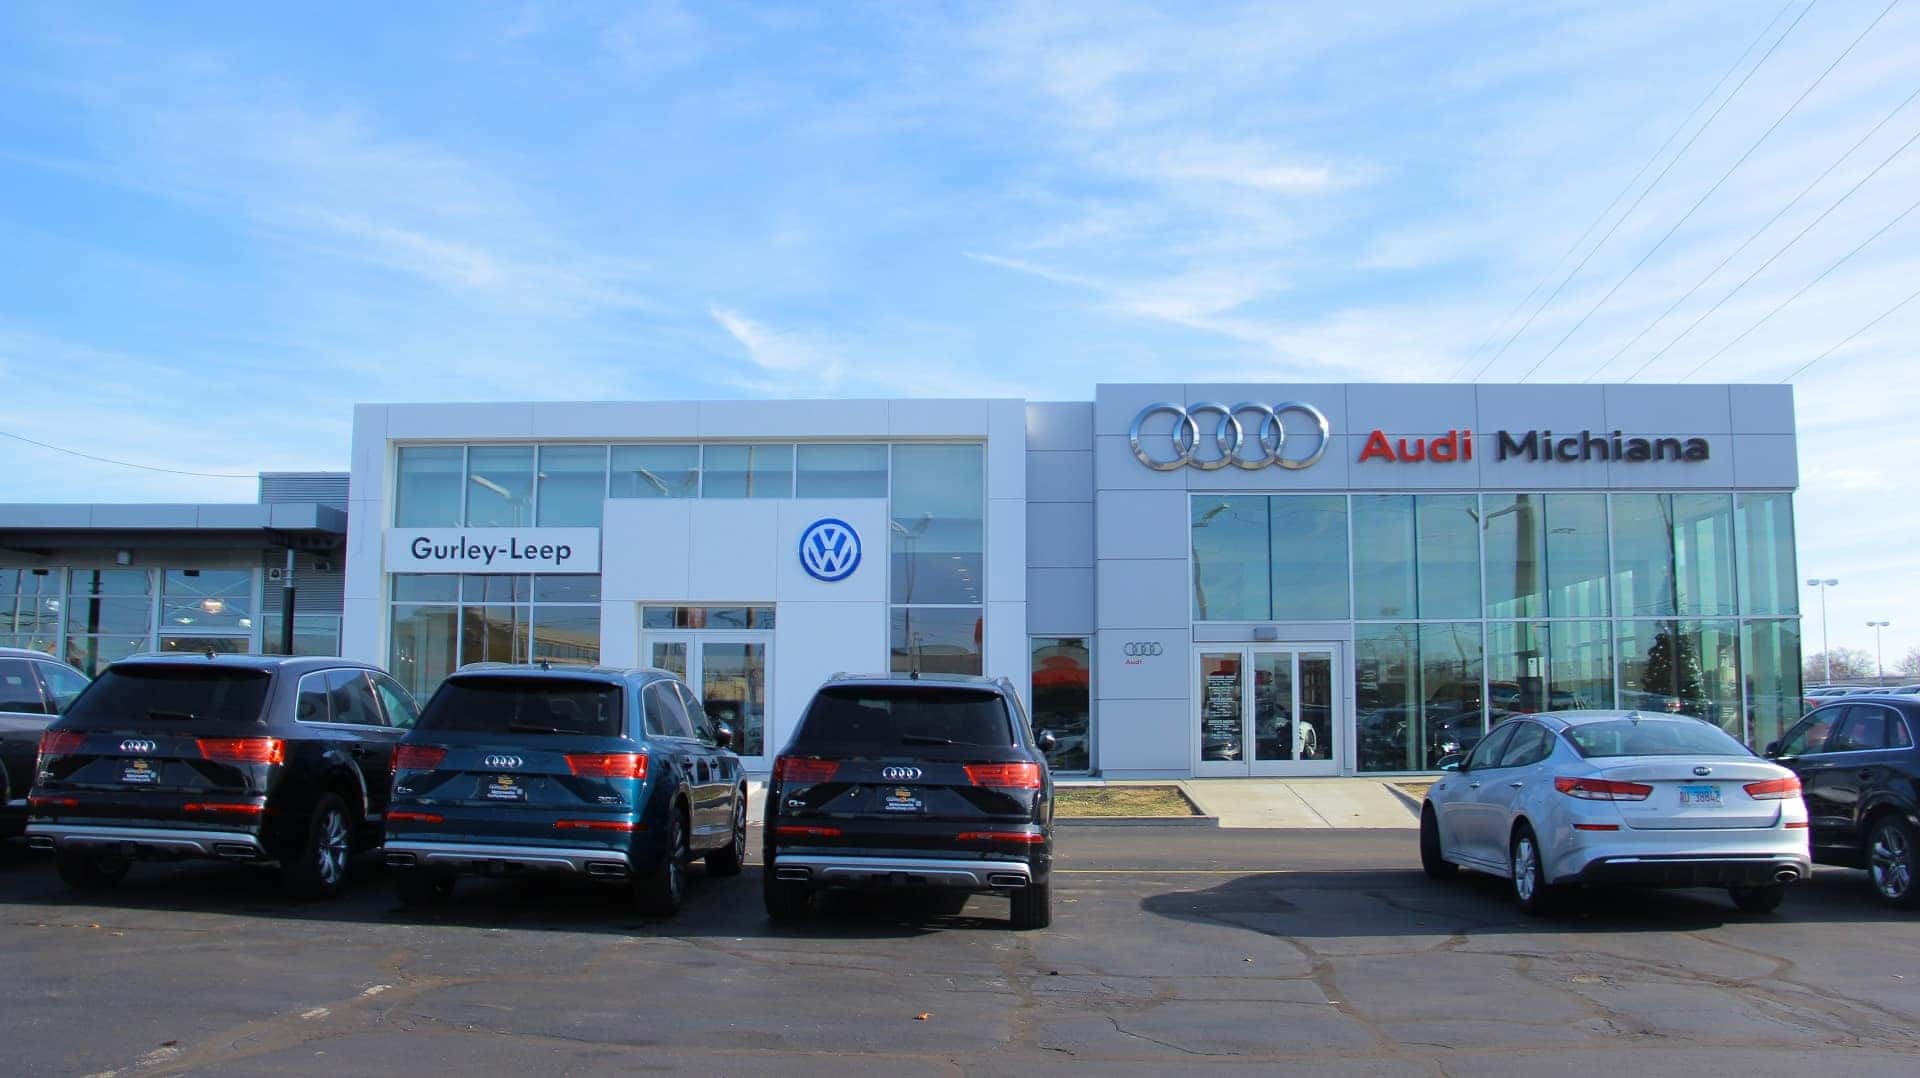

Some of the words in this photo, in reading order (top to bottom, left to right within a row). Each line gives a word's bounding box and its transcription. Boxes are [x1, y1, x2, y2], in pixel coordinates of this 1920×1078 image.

[1359, 429, 1473, 463] Audi
[1497, 430, 1710, 462] Michiana
[411, 535, 572, 565] Gurley-Leep
